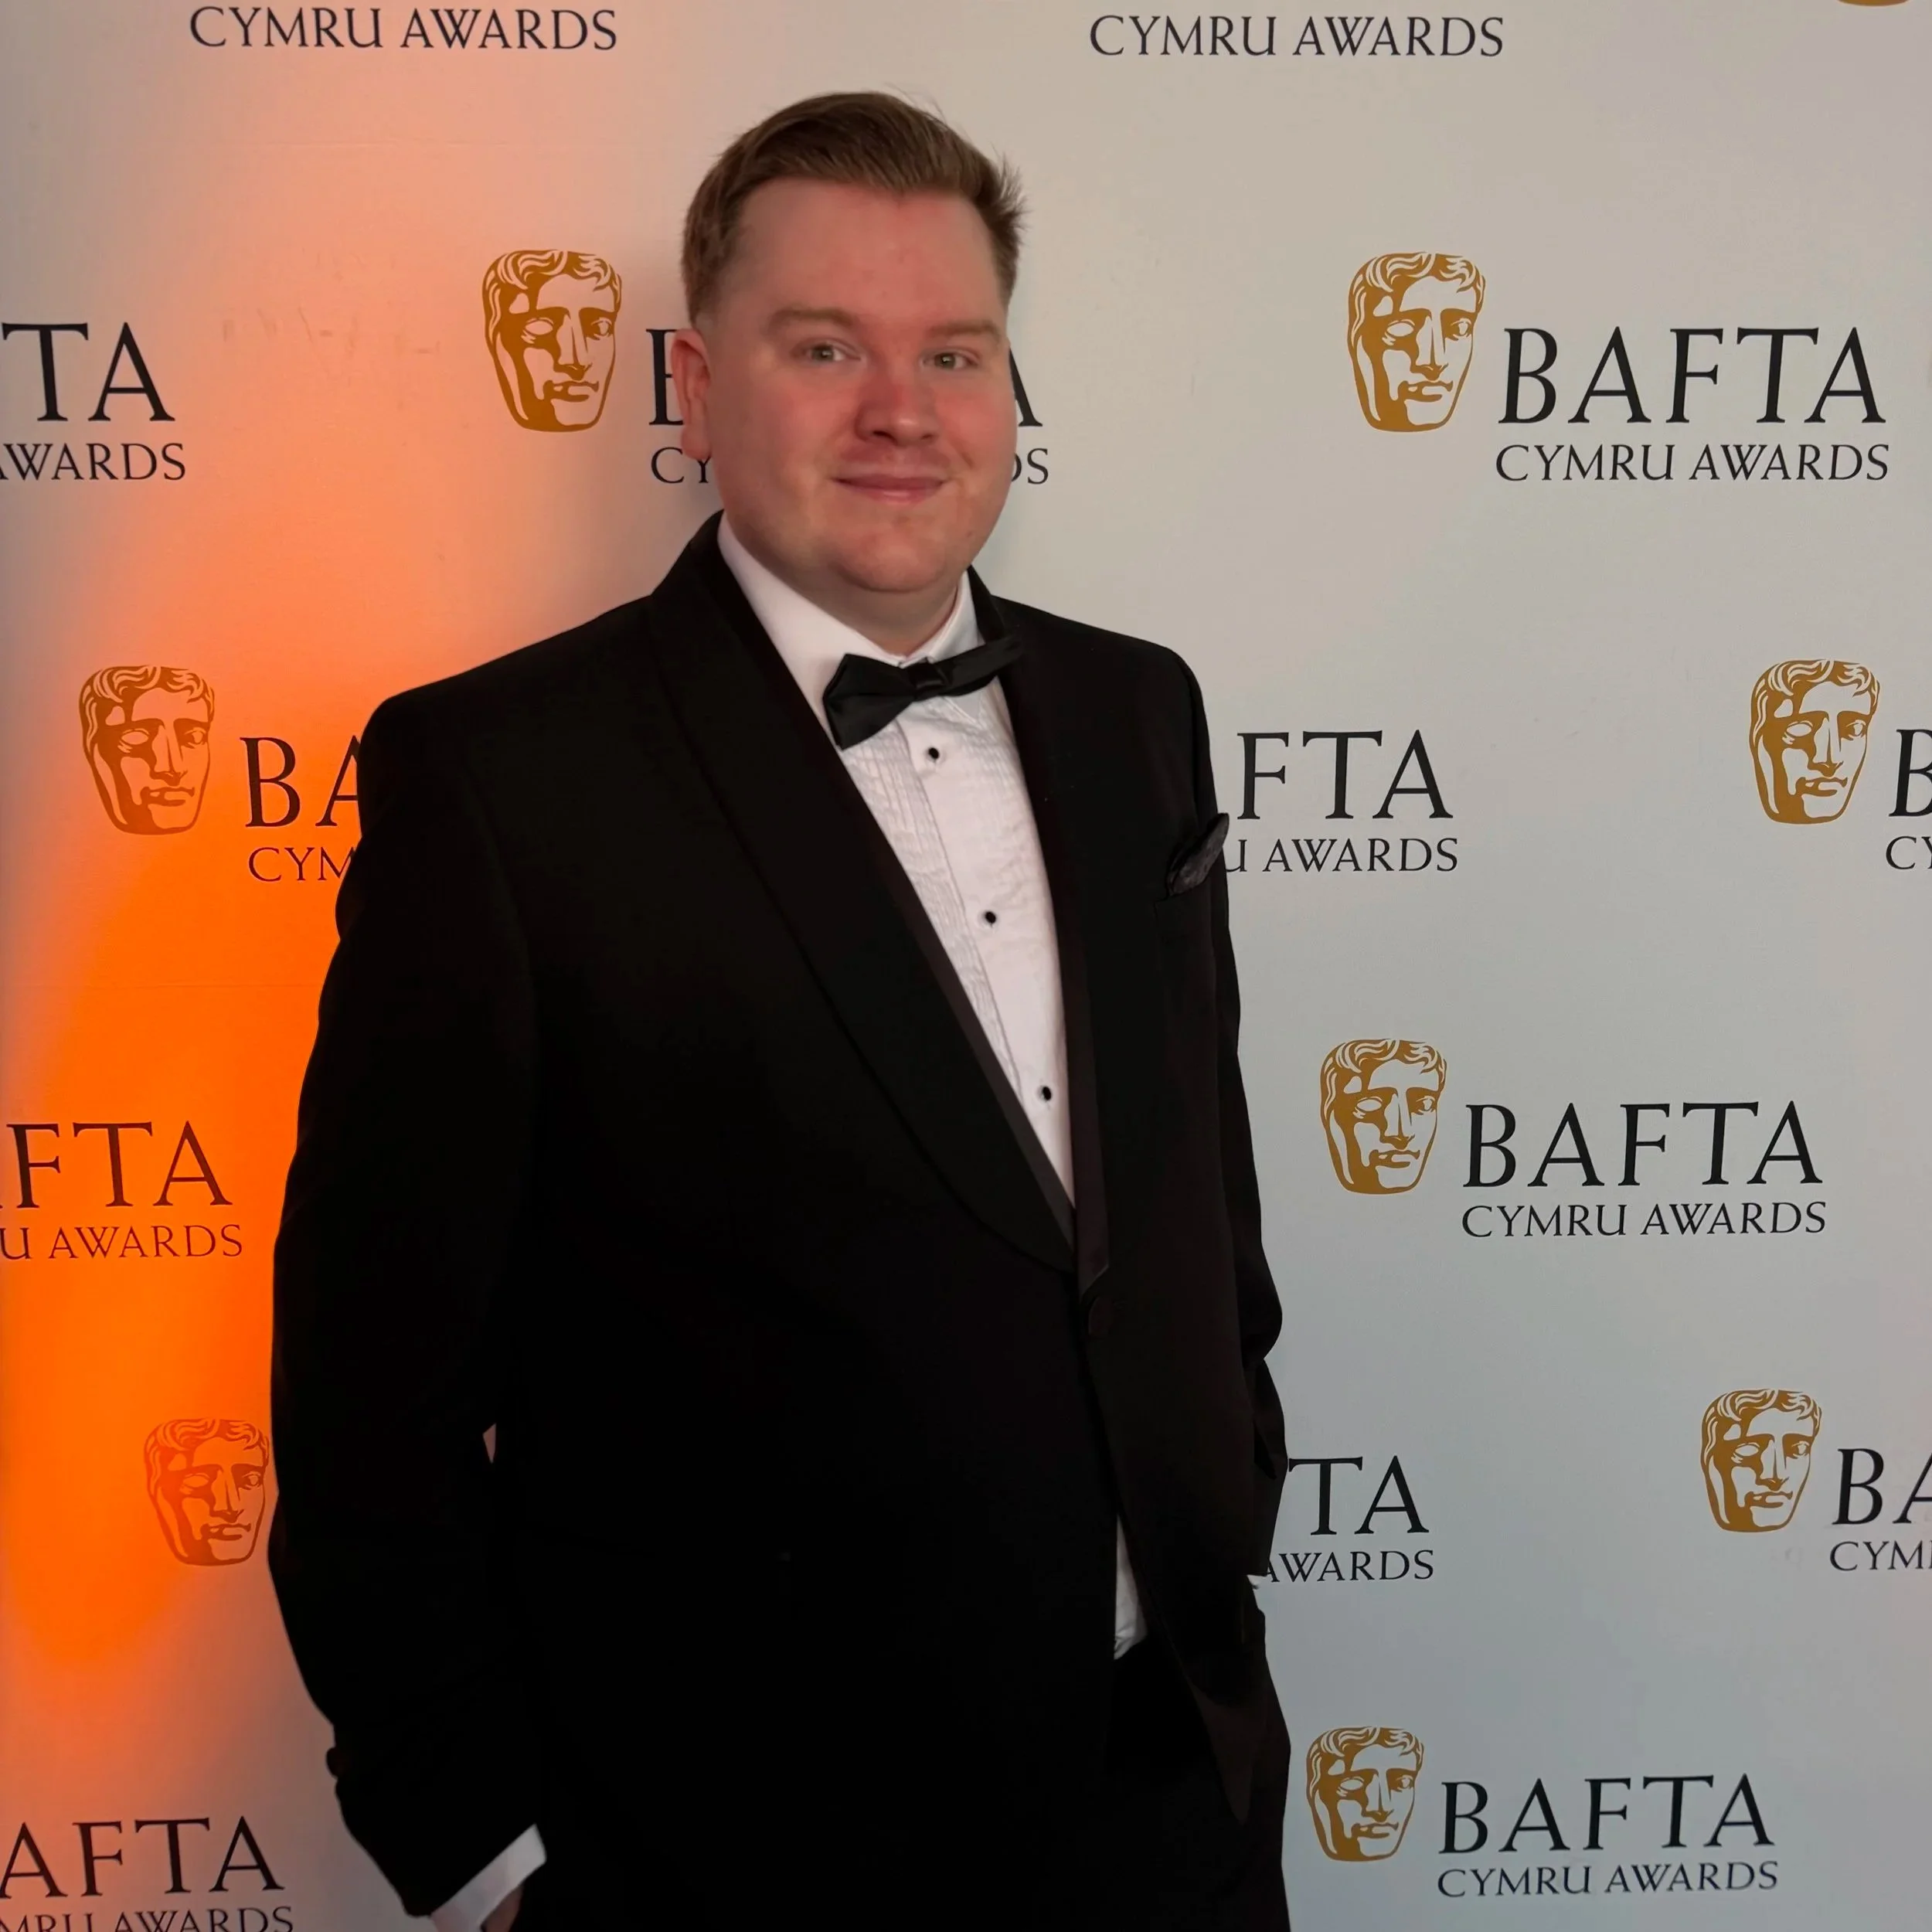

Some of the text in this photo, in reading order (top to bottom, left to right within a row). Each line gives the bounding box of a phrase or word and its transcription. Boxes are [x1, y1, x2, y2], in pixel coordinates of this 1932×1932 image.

[190, 6, 617, 50] CYMRU AWARDS
[1090, 15, 1503, 56] CYMRU AWARDS
[1, 321, 176, 422] TA
[1498, 326, 1886, 424] BAFTA
[1495, 444, 1889, 481] CYMRU AWARDS
[1236, 729, 1454, 820] FTA
[1261, 838, 1458, 872] AWARDS
[0, 1121, 233, 1209] FTA
[1462, 1100, 1824, 1188] BAFTA
[49, 1224, 243, 1259] AWARDS
[1461, 1201, 1826, 1238] CYMRU AWARDS
[1829, 1540, 1932, 1572] CYM
[1437, 1772, 1776, 1855] BAFTA
[0, 1815, 286, 1900] AFTA
[1437, 1860, 1778, 1898] CYMRU AWARDS
